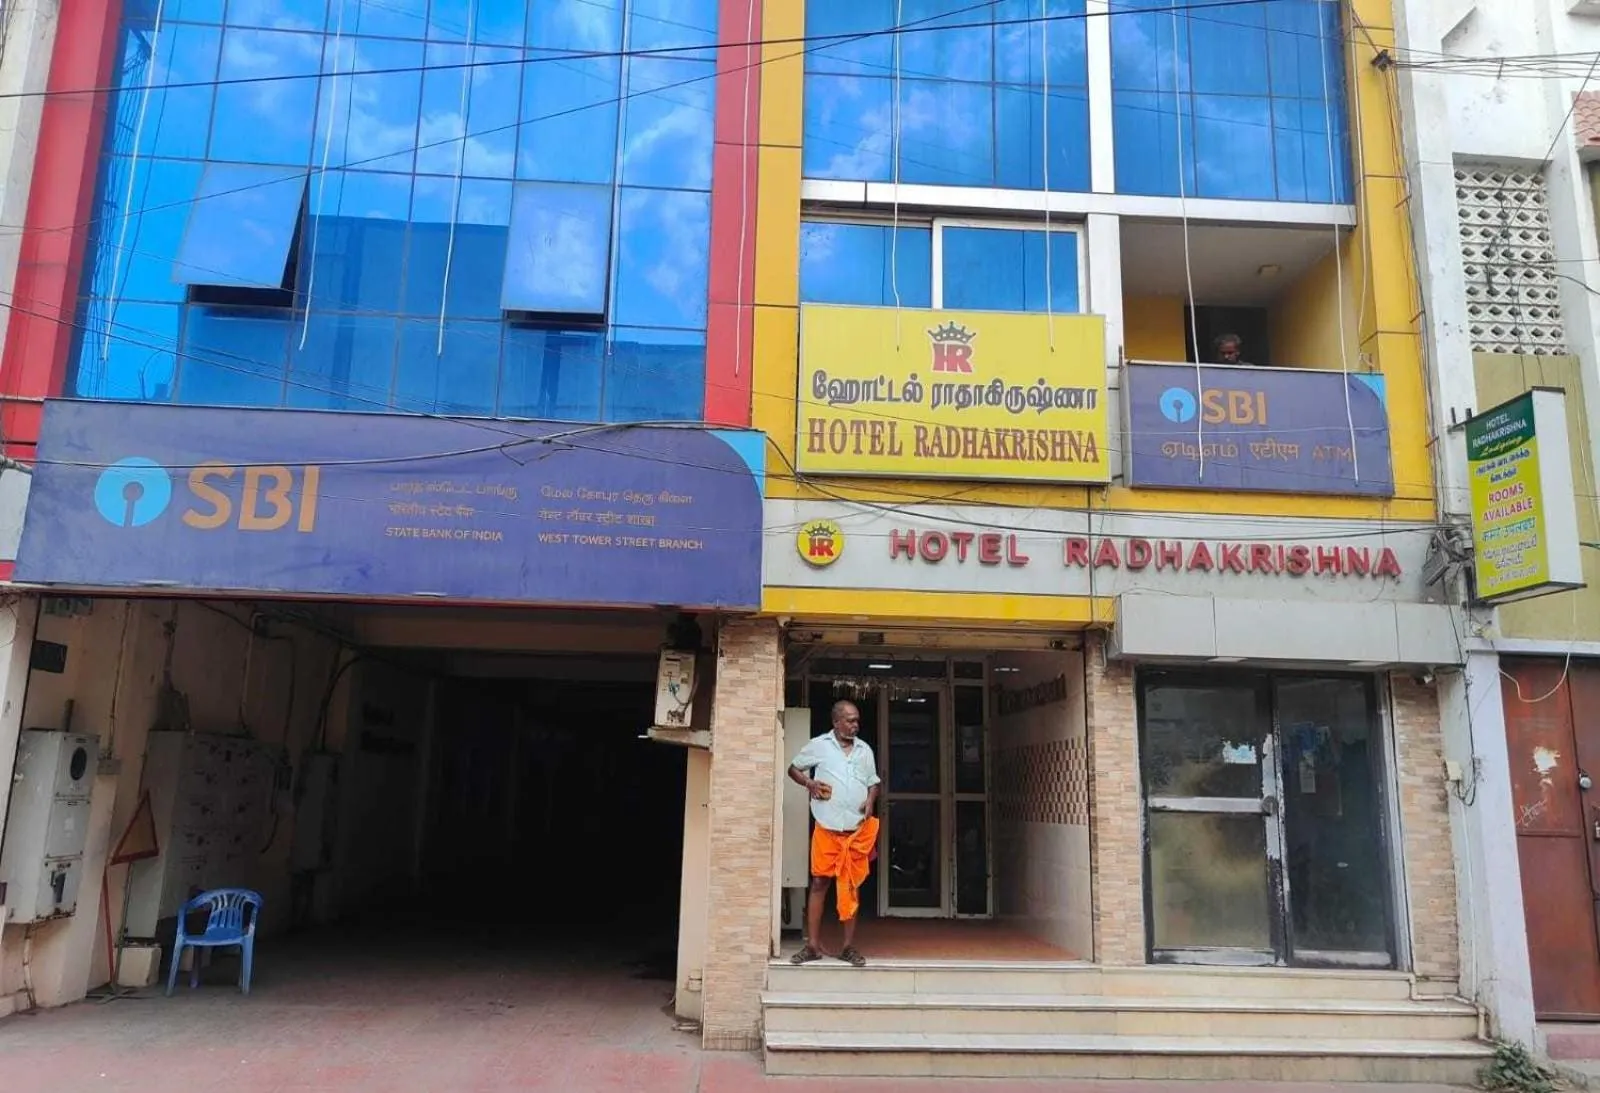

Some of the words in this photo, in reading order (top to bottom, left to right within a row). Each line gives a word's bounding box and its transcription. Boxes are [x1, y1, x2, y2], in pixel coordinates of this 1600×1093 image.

[932, 343, 973, 373] HR
[812, 369, 923, 407] ஹோட்டல்
[931, 378, 1098, 416] ராதாகிருஷ்ணா
[1203, 389, 1268, 425] SBI
[1486, 412, 1511, 430] HOTEL
[807, 418, 904, 457] HOTEL
[914, 425, 1099, 464] RADHAKRISHNA
[1251, 439, 1300, 462] एटीएम
[1312, 445, 1351, 462] ATM
[182, 460, 320, 533] SBI
[1488, 482, 1523, 503] ROOMS
[385, 527, 419, 538] STATE
[422, 528, 452, 539] BANK
[454, 530, 470, 540] OF
[472, 531, 503, 541] INDIA
[538, 532, 569, 545] WEST
[572, 534, 611, 546] TOWER
[616, 536, 655, 548] STREET
[659, 538, 703, 550] BRANCH
[808, 536, 834, 557] HR
[889, 529, 1029, 567] HOTEL
[1063, 537, 1402, 577] RADHAKRISHNA
